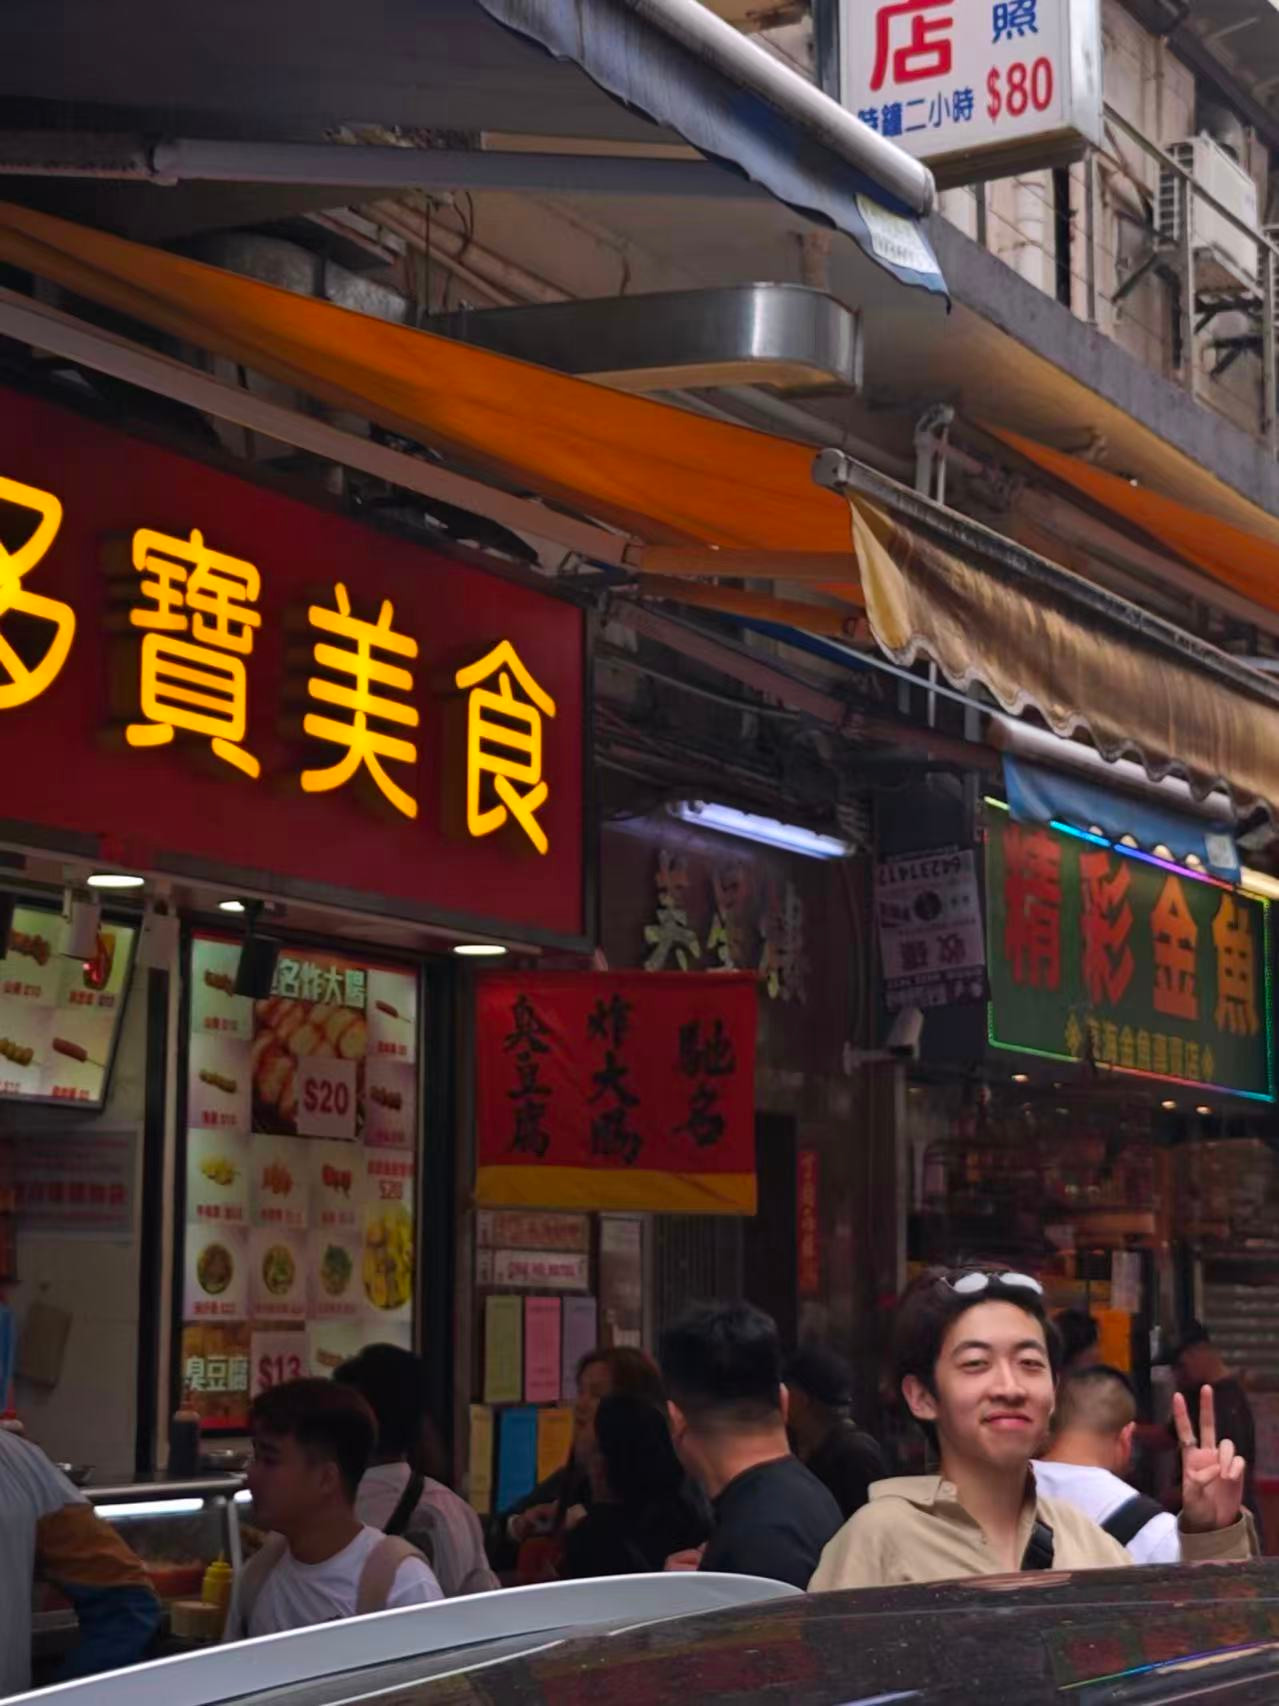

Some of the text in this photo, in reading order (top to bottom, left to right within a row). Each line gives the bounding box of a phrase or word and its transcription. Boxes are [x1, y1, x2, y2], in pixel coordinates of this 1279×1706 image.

[869, 0, 954, 91] 店
[992, 0, 1039, 43] 照
[986, 57, 1053, 125] $80
[1003, 822, 1258, 1036] 精彩金魚
[271, 959, 365, 1008] 名炸大腸
[303, 1076, 349, 1116] $20
[184, 1355, 248, 1391] 臭豆腐
